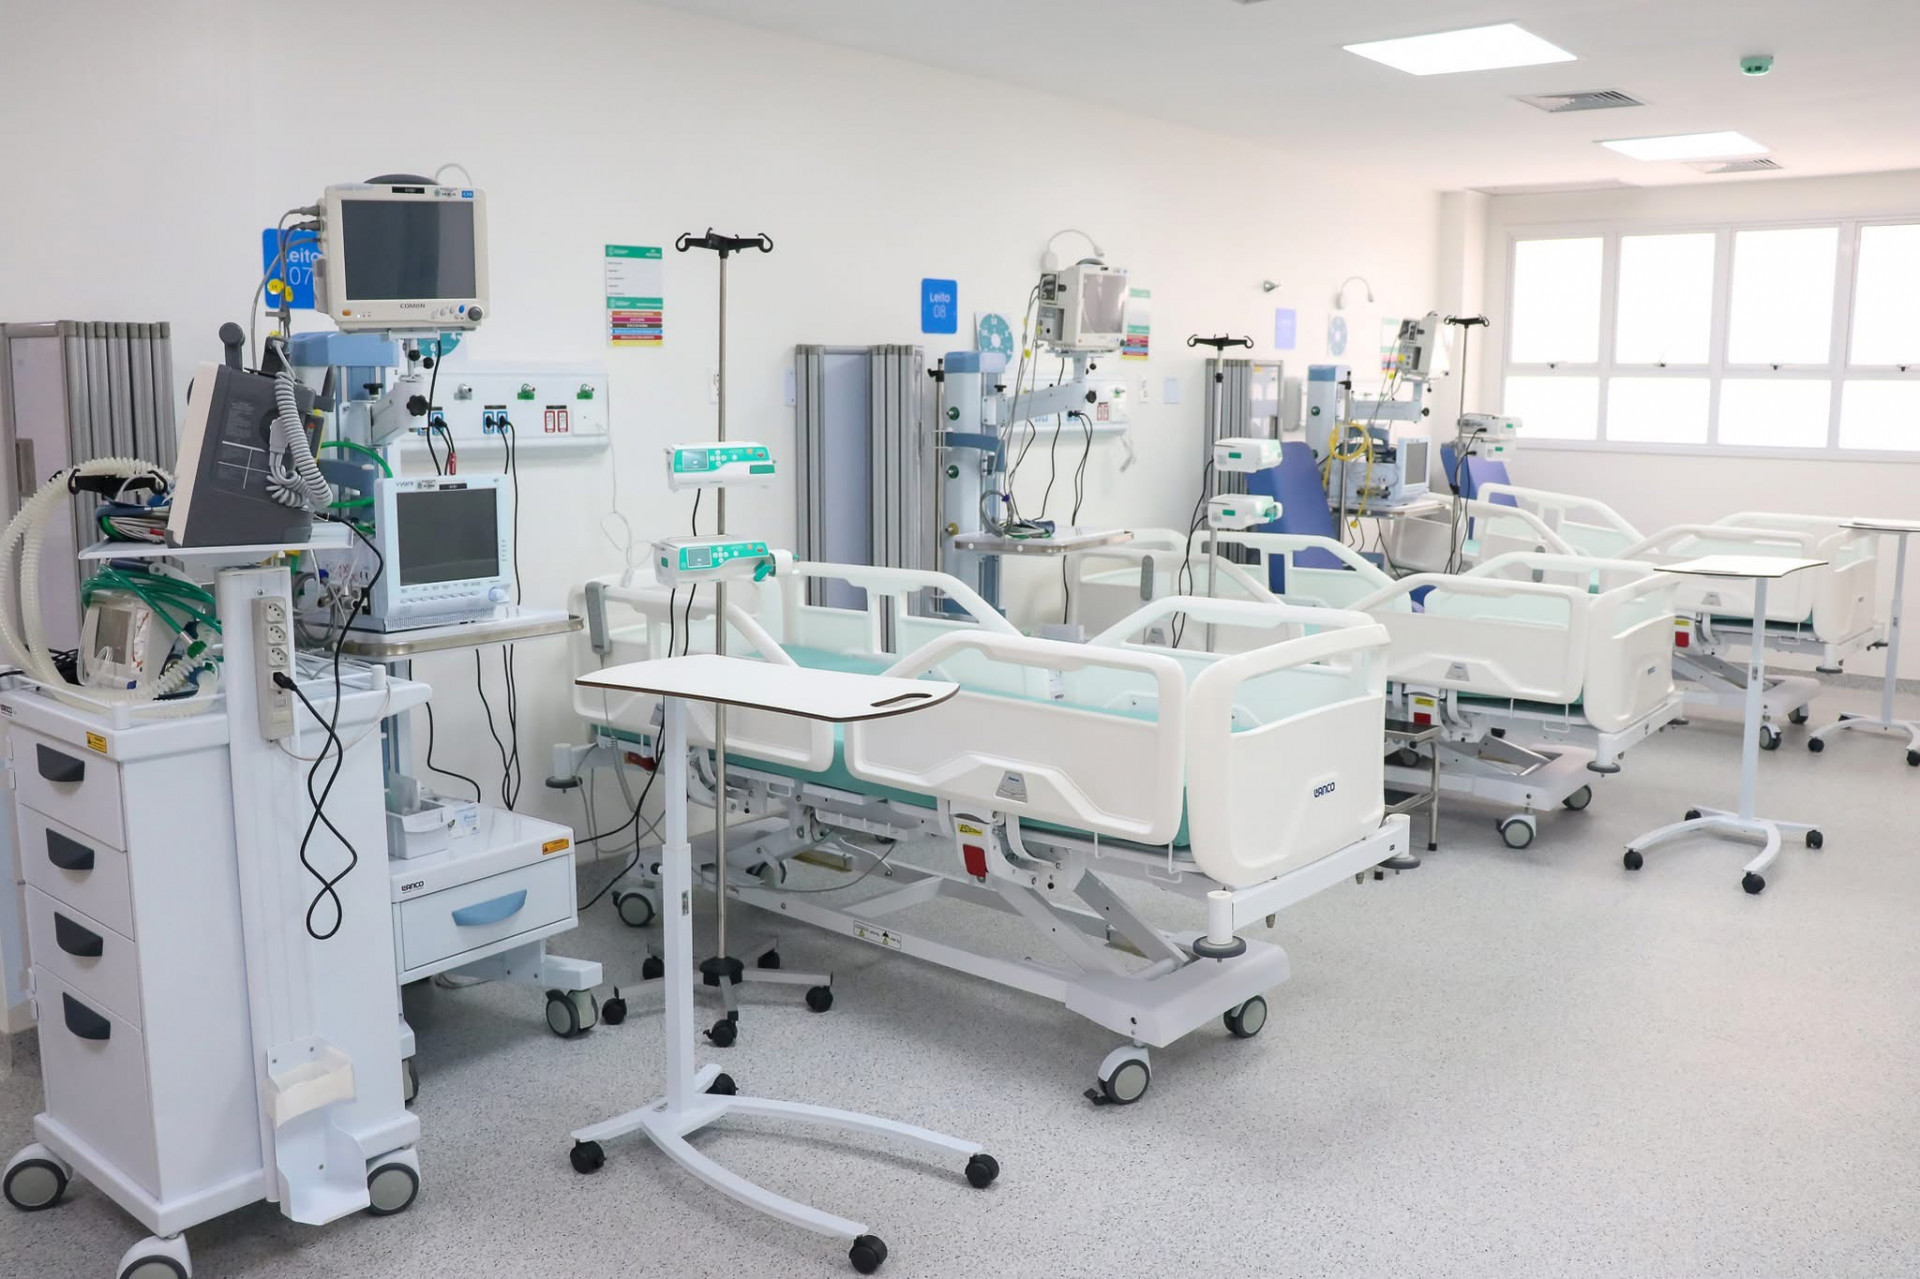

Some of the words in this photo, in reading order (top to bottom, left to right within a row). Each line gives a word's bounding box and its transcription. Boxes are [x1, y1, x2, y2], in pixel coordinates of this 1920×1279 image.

[286, 248, 320, 264] eito
[289, 266, 313, 286] 07
[930, 292, 950, 303] Leito
[933, 305, 946, 318] 08
[430, 342, 436, 352] 6
